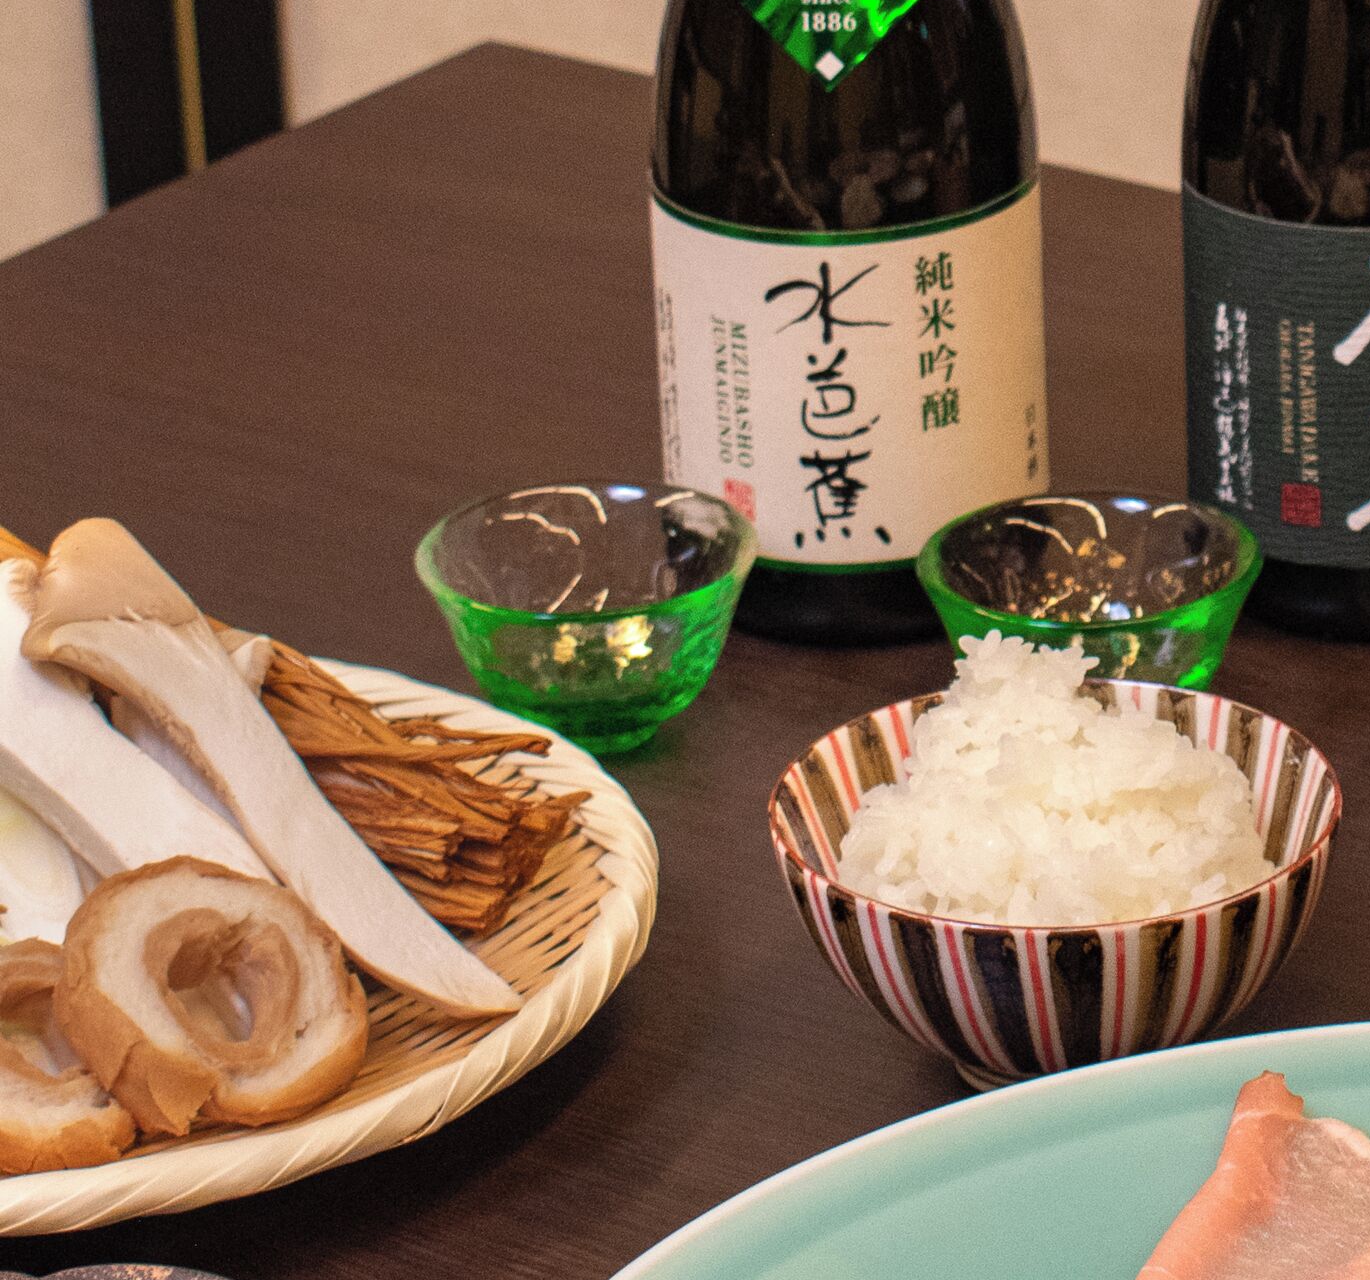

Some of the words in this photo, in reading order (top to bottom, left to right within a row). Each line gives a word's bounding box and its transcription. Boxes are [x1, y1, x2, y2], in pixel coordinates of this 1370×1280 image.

[799, 10, 857, 34] 1886
[711, 316, 733, 464] JUNMAIGINJO
[731, 322, 754, 469] MIZUBASHO
[763, 261, 893, 548] 水芭蕉
